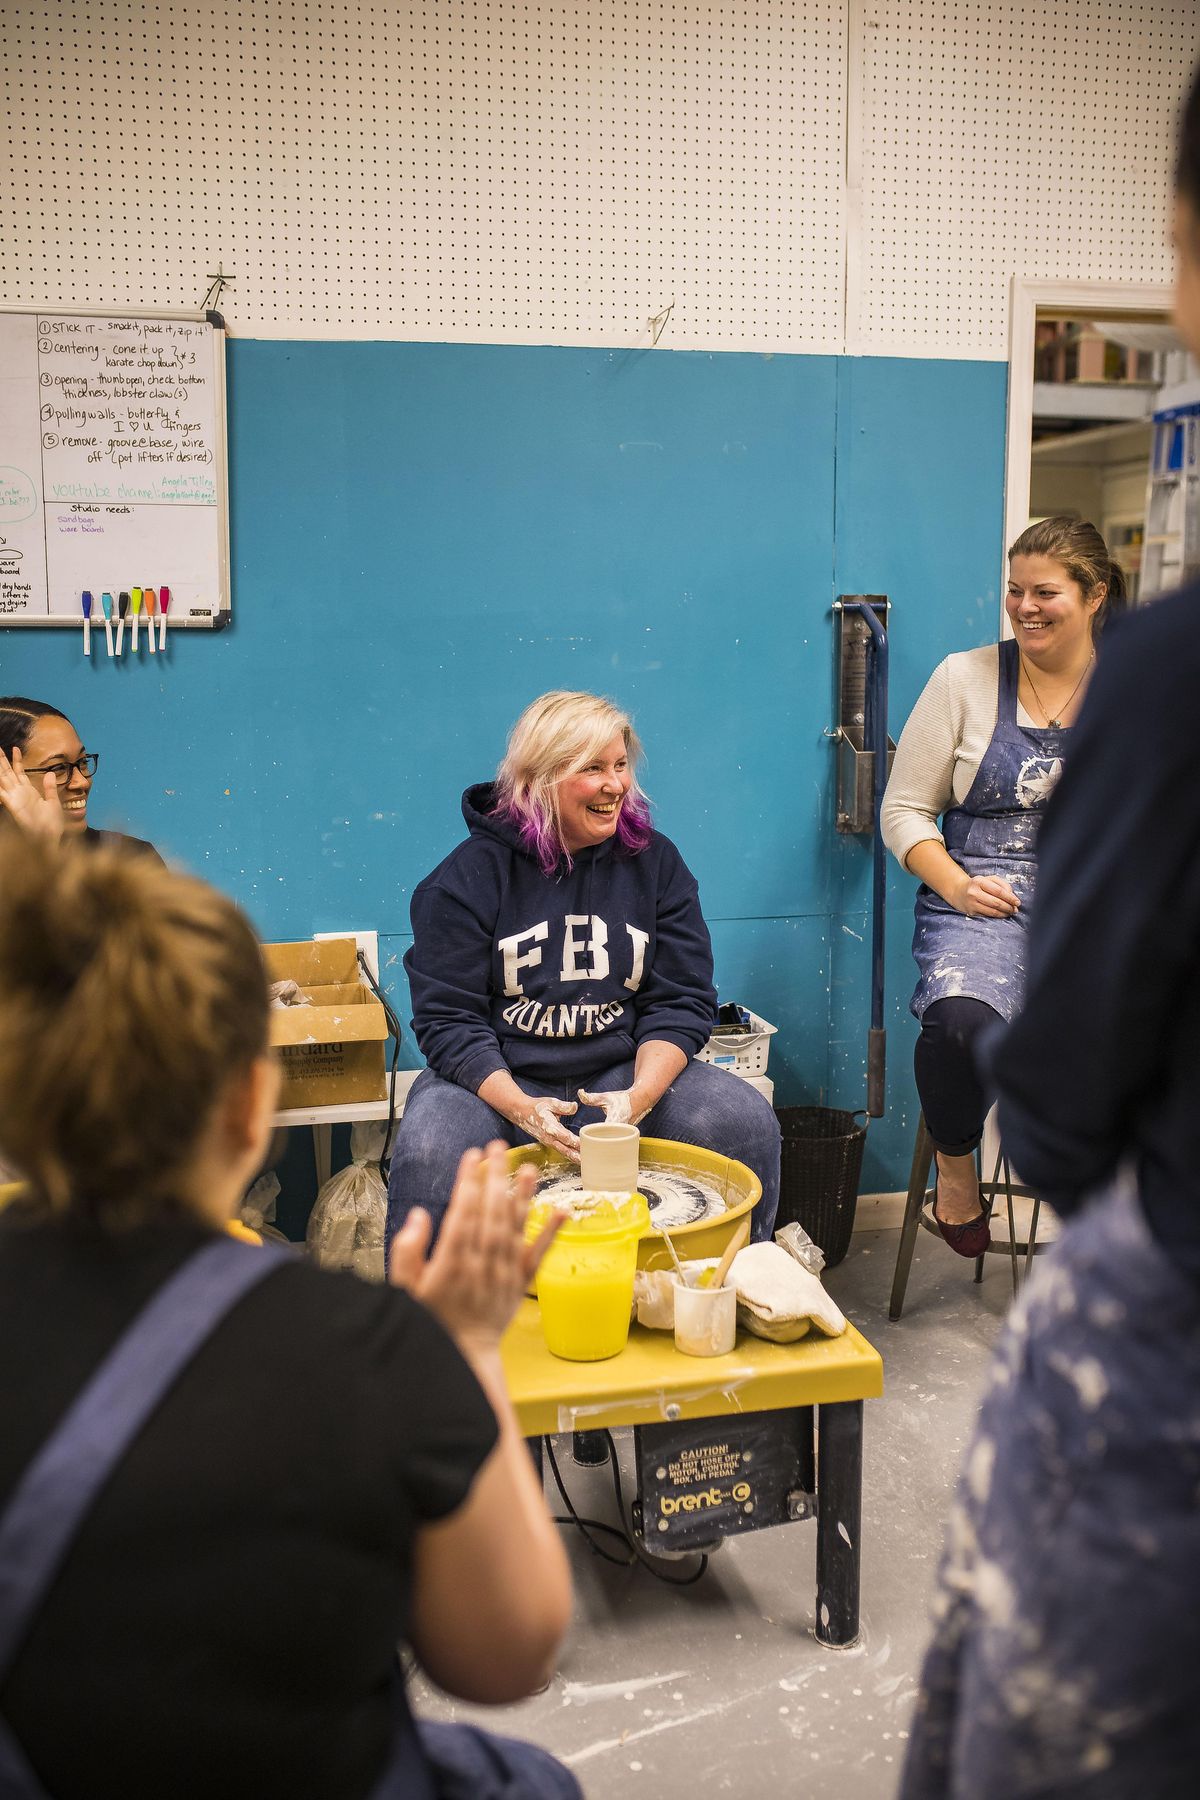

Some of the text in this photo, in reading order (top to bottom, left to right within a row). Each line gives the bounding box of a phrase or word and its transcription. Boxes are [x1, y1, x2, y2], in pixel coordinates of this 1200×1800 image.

[144, 324, 163, 339] pack
[177, 327, 192, 342] zip
[54, 340, 99, 361] centering
[113, 345, 137, 354] cone
[140, 344, 148, 354] it
[152, 347, 164, 358] up
[105, 356, 134, 367] karate
[54, 376, 88, 394] opening
[148, 375, 175, 384] check
[178, 374, 206, 384] bottom
[114, 387, 148, 398] lobster
[88, 408, 116, 420] walls
[128, 406, 170, 428] butterfly
[182, 438, 205, 448] wire
[88, 450, 103, 463] off
[498, 914, 650, 997] FBI
[680, 1444, 728, 1460] CAUTION!
[668, 1453, 740, 1472] DO NOT HOSE OFF
[702, 1460, 740, 1474] CONTROL
[694, 1473, 706, 1482] OR
[708, 1468, 735, 1479] PEDAL
[660, 1487, 722, 1515] brent
